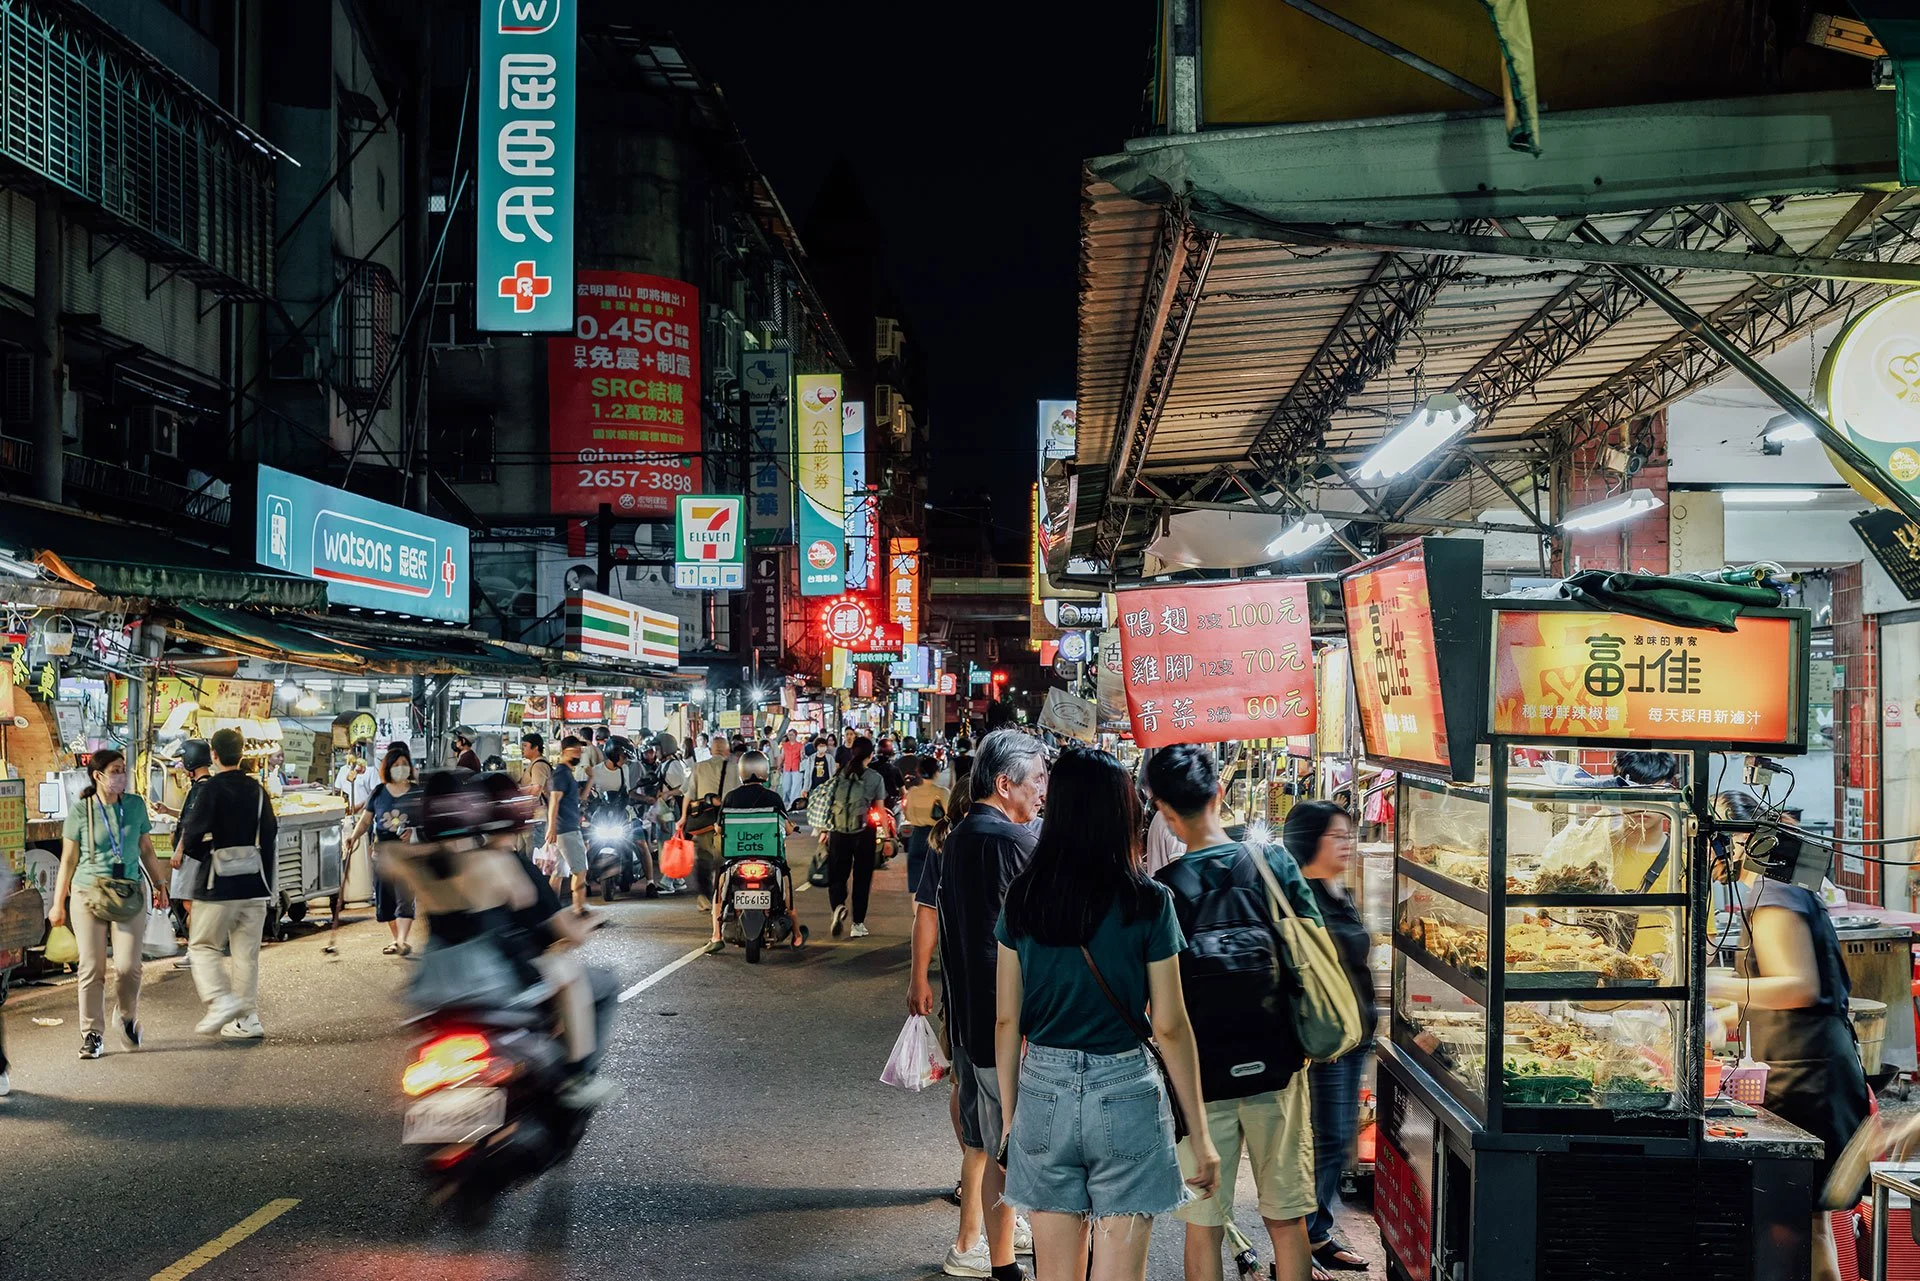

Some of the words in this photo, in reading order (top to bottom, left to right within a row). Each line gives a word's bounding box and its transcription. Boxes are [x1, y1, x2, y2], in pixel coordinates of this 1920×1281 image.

[497, 53, 556, 243] 屈臣氏
[577, 315, 673, 347] 0.45G
[591, 377, 684, 405] SRC結構
[592, 403, 685, 425] 1.2萬磅水泥
[812, 420, 829, 490] 公益彩券
[578, 470, 692, 493] 2657-3898
[323, 528, 392, 573] watsons
[1125, 605, 1190, 638] 鴨翅
[1197, 613, 1222, 630] 3支
[1227, 597, 1303, 629] 100元
[1633, 634, 1698, 647] 滷味的專家
[1131, 653, 1194, 686] 雞腳
[1200, 659, 1235, 677] 12支
[1241, 643, 1306, 675] 70元
[1137, 698, 1198, 732] 青菜
[1245, 689, 1310, 720] 60元
[1648, 707, 1761, 724] 每天採用新滷汁
[737, 831, 764, 841] Uber
[737, 842, 764, 852] Eats
[736, 895, 770, 905] PCG-6155
